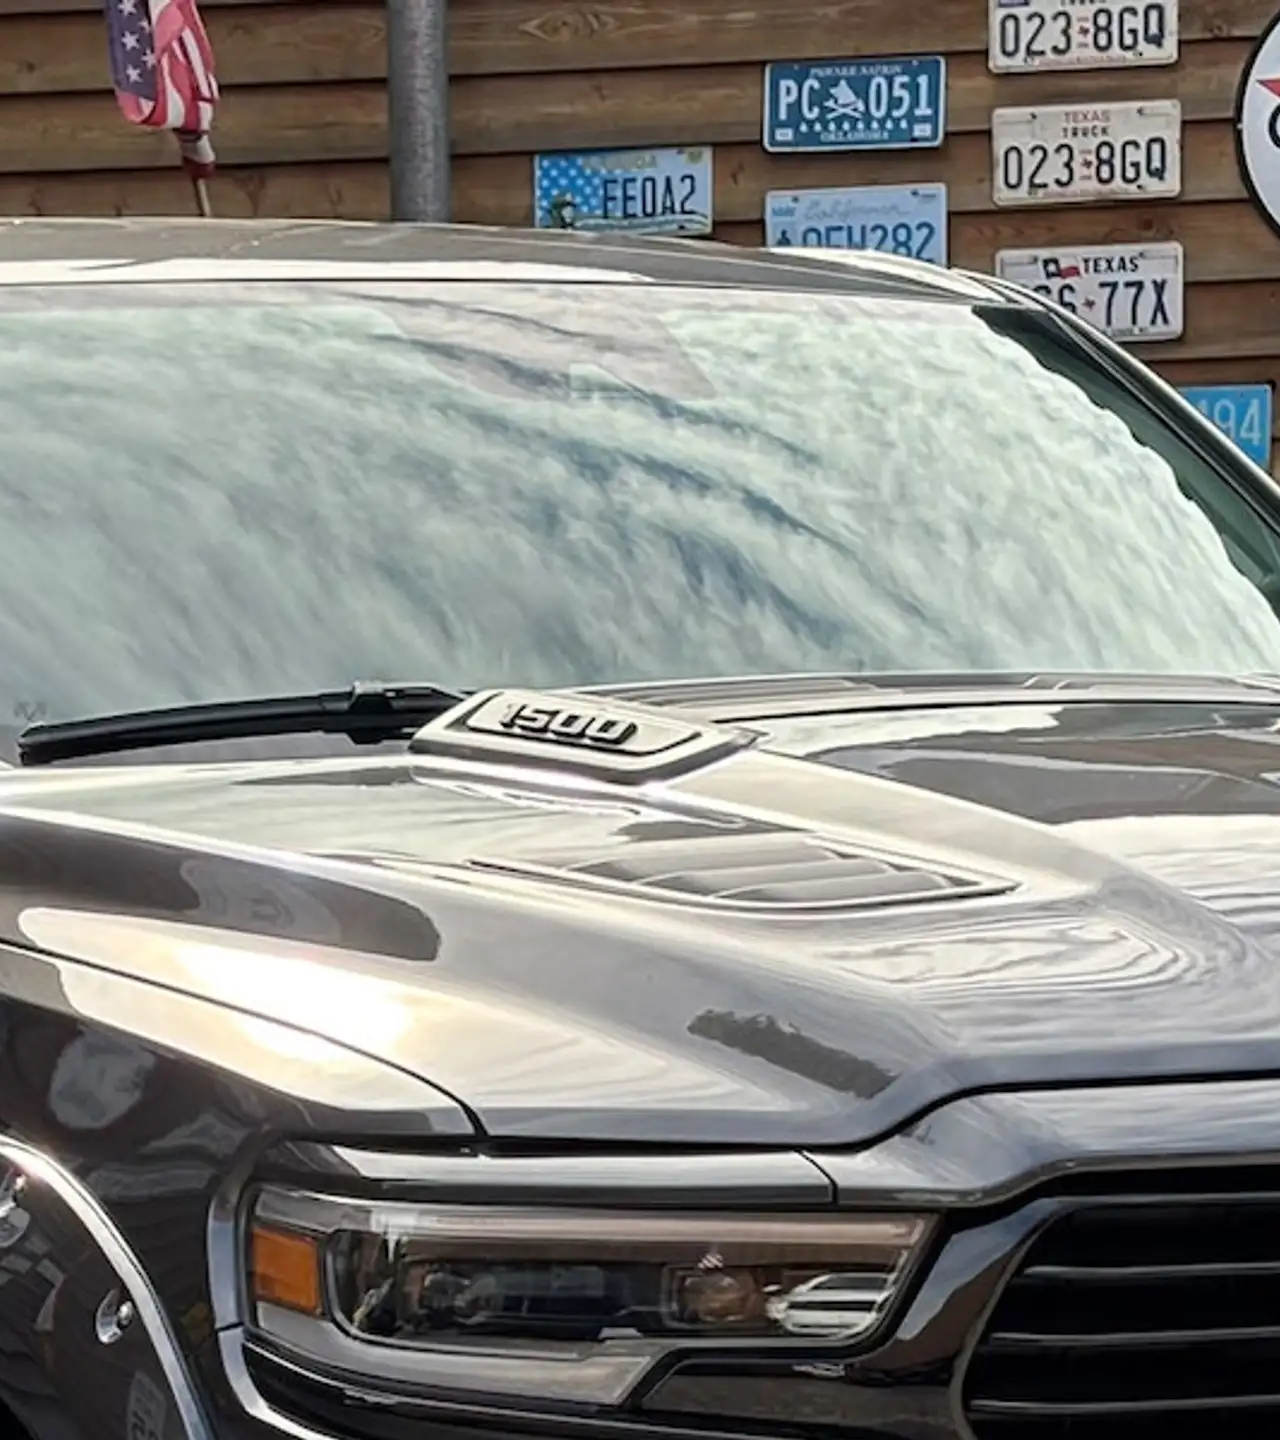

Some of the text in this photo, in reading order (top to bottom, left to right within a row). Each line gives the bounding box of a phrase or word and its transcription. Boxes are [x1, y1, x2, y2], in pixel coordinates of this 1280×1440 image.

[999, 3, 1166, 57] 023 8GQ
[777, 73, 934, 121] PC 051
[1062, 109, 1112, 124] TEXAS
[1061, 125, 1110, 139] TRUCK
[1004, 136, 1167, 190] 023 8GQ
[1081, 256, 1140, 275] TEXAS
[1098, 278, 1170, 327] 77X
[501, 701, 640, 746] 1500
